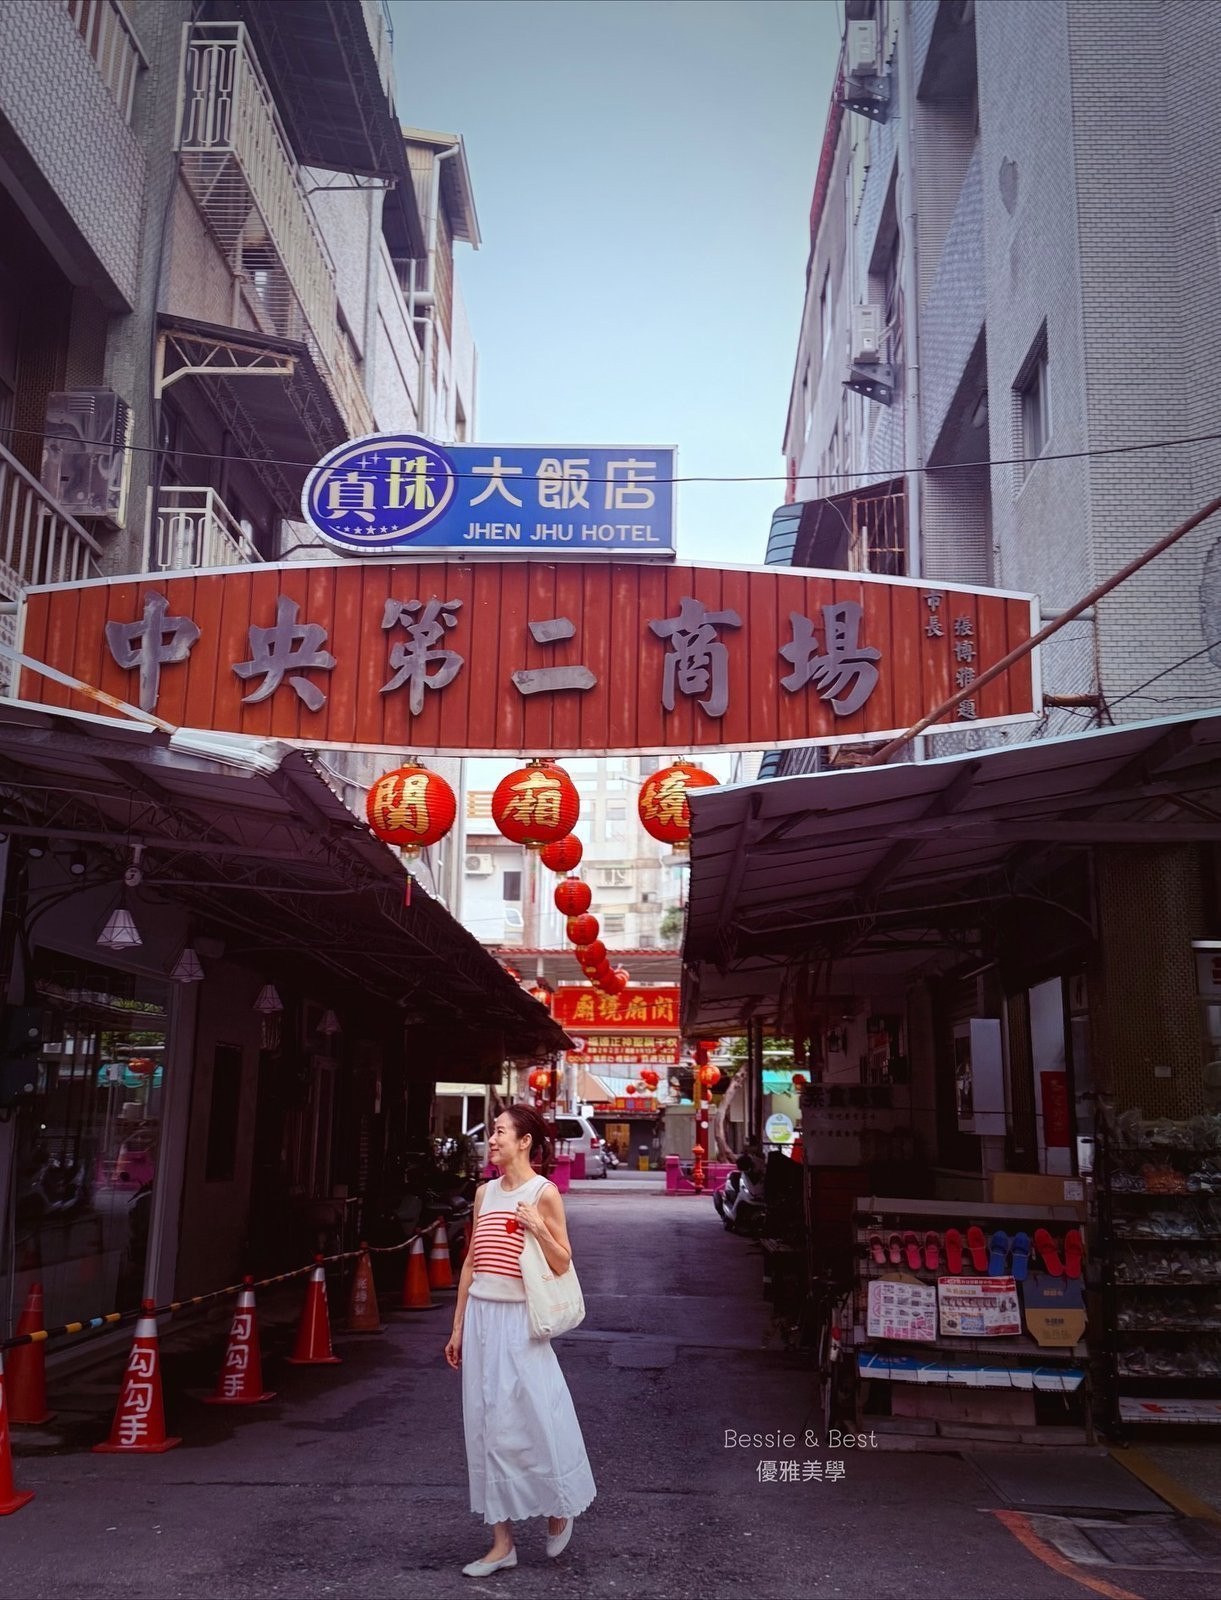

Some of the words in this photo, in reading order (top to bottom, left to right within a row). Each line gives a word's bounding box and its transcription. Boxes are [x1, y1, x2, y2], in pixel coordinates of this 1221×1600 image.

[327, 455, 436, 523] 真珠
[469, 456, 657, 510] 大飯店
[463, 523, 521, 541] JHEN
[530, 523, 574, 541] JHU
[581, 523, 660, 542] HOTEL
[923, 591, 945, 637] 市長
[105, 590, 882, 717] 中央第二商場
[223, 1313, 252, 1397] 勾勾手
[119, 1344, 155, 1445] 勾勾手
